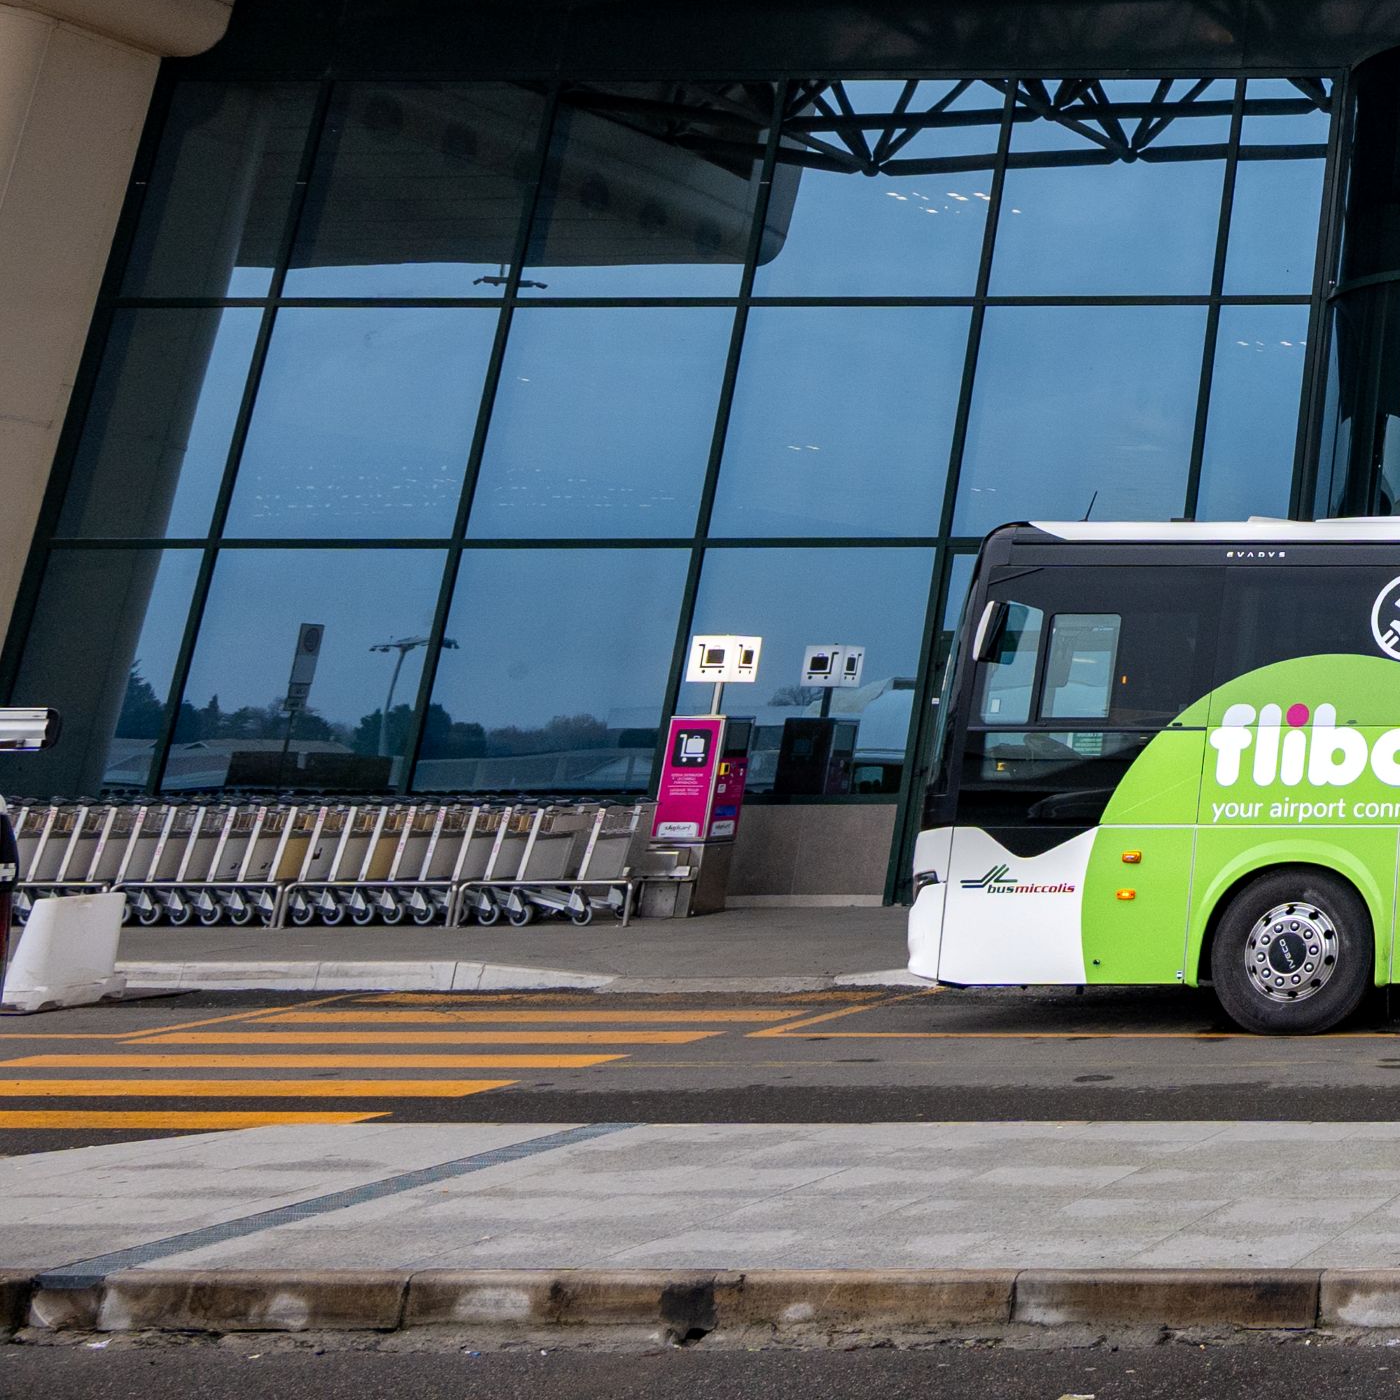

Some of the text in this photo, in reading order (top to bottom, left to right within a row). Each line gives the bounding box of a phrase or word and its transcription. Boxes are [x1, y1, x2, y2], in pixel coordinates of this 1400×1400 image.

[1211, 801, 1263, 822] your
[1269, 797, 1346, 822] airport
[987, 883, 1076, 894] busmiccolis
